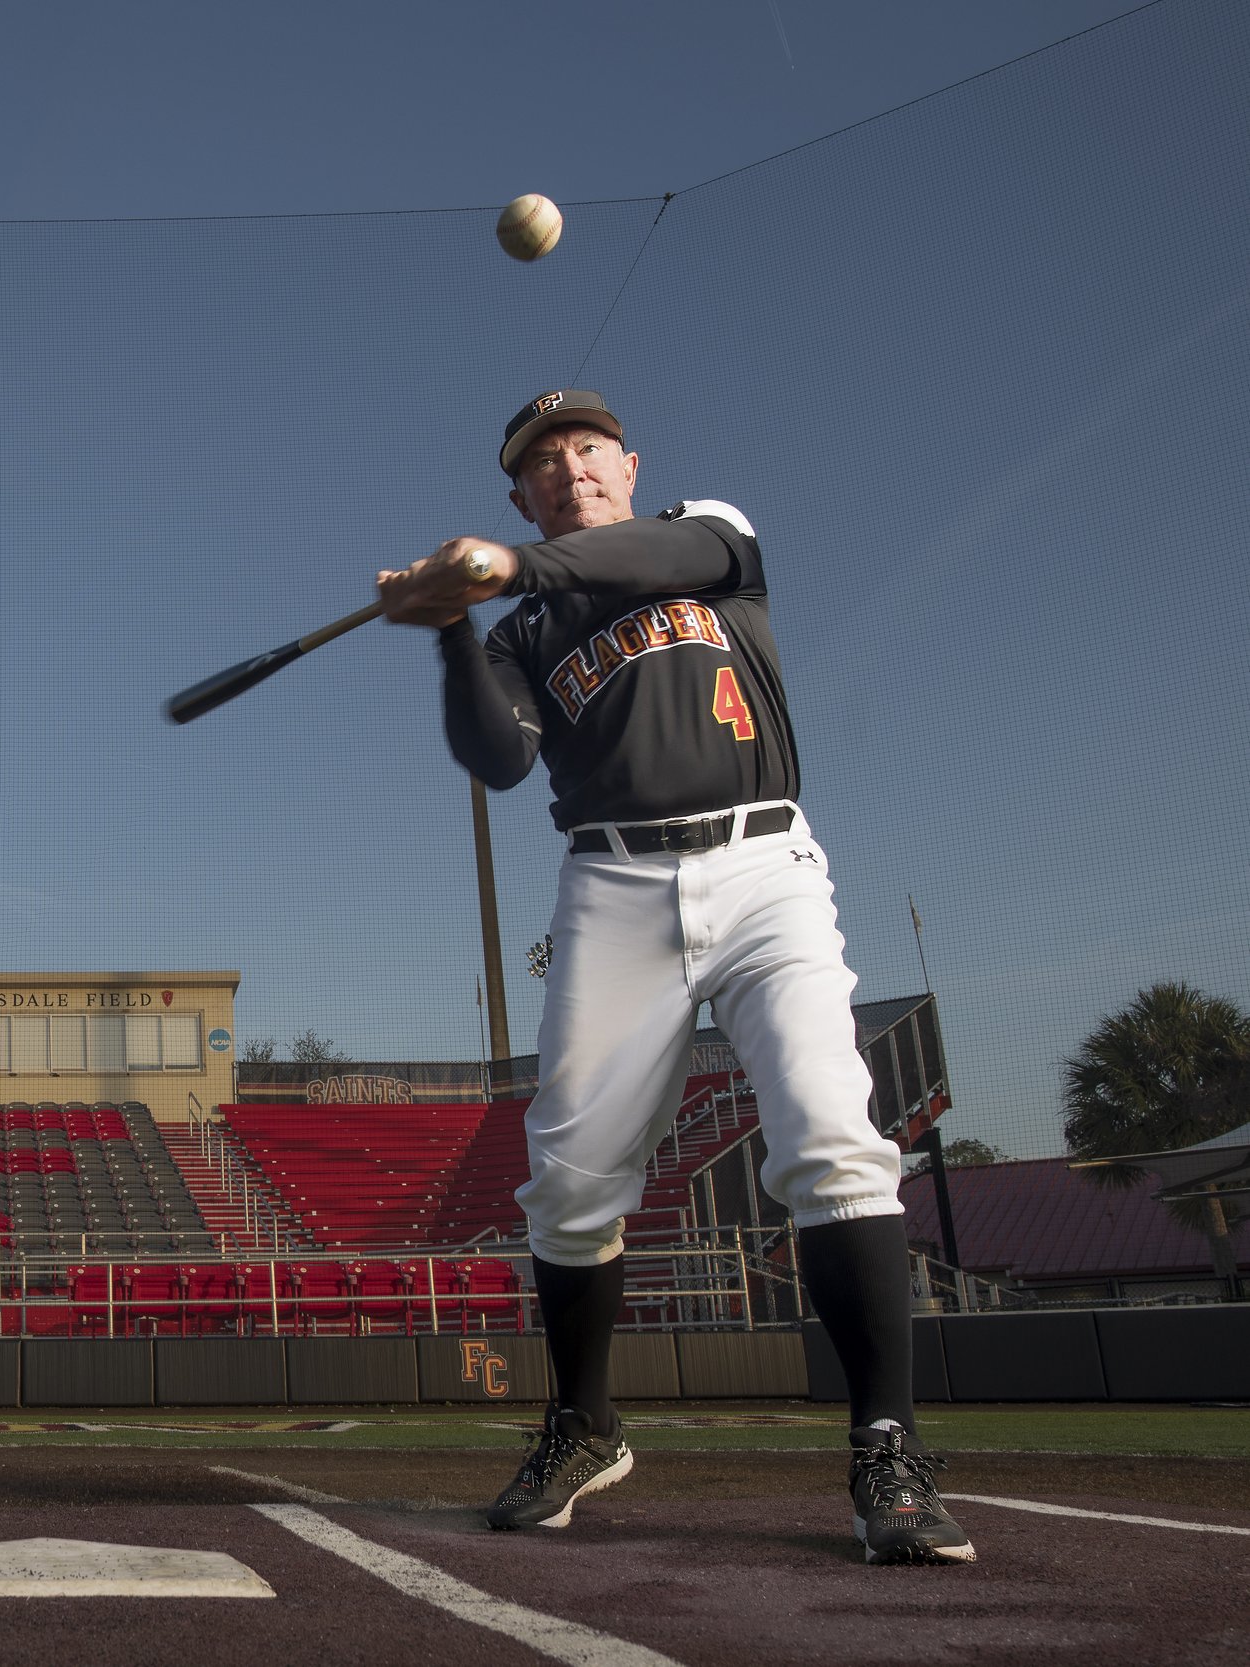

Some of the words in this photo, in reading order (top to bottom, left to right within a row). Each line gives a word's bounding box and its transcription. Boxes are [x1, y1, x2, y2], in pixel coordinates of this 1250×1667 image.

[546, 600, 731, 725] FLAGLER
[712, 666, 756, 742] 4
[86, 993, 152, 1007] FIELD
[307, 1075, 413, 1104] SAINTS
[459, 1339, 509, 1397] FC
